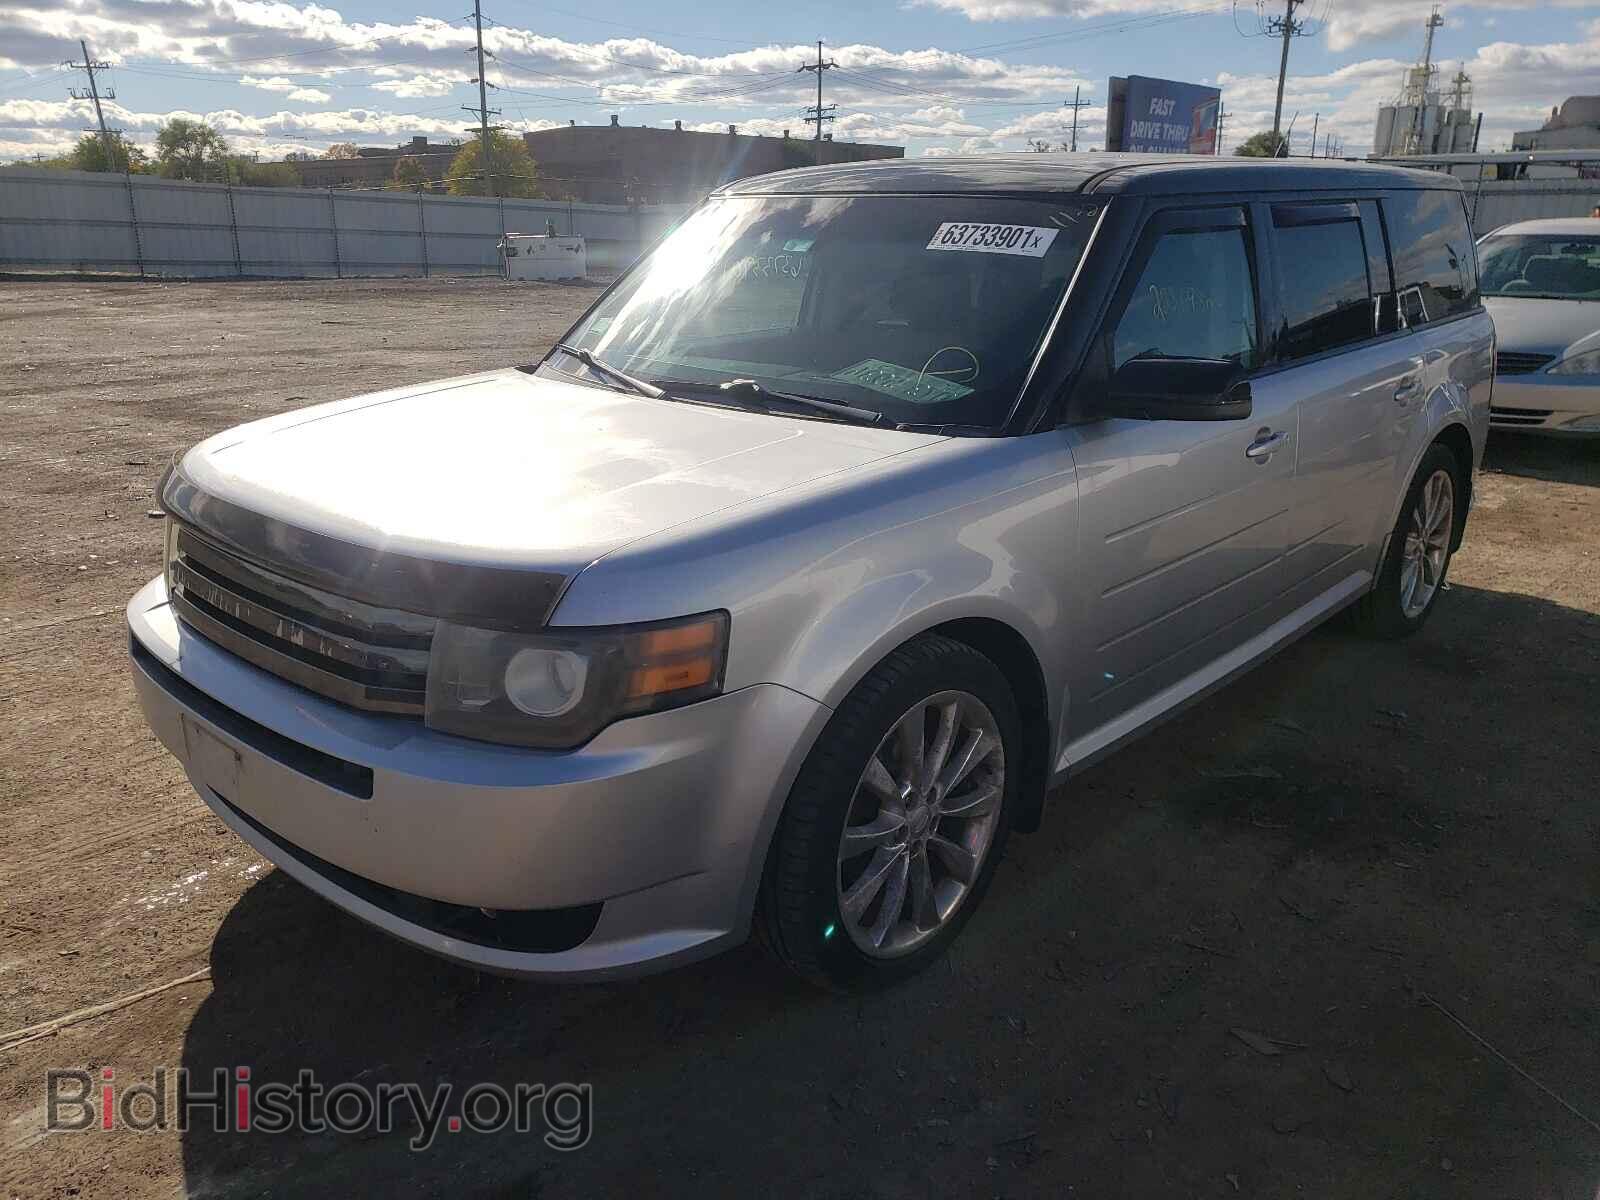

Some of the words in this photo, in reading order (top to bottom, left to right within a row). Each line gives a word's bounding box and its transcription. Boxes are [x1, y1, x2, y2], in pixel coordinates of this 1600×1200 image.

[1149, 98, 1177, 116] FAST
[1130, 119, 1161, 139] DRIVE
[1162, 123, 1190, 143] THRU
